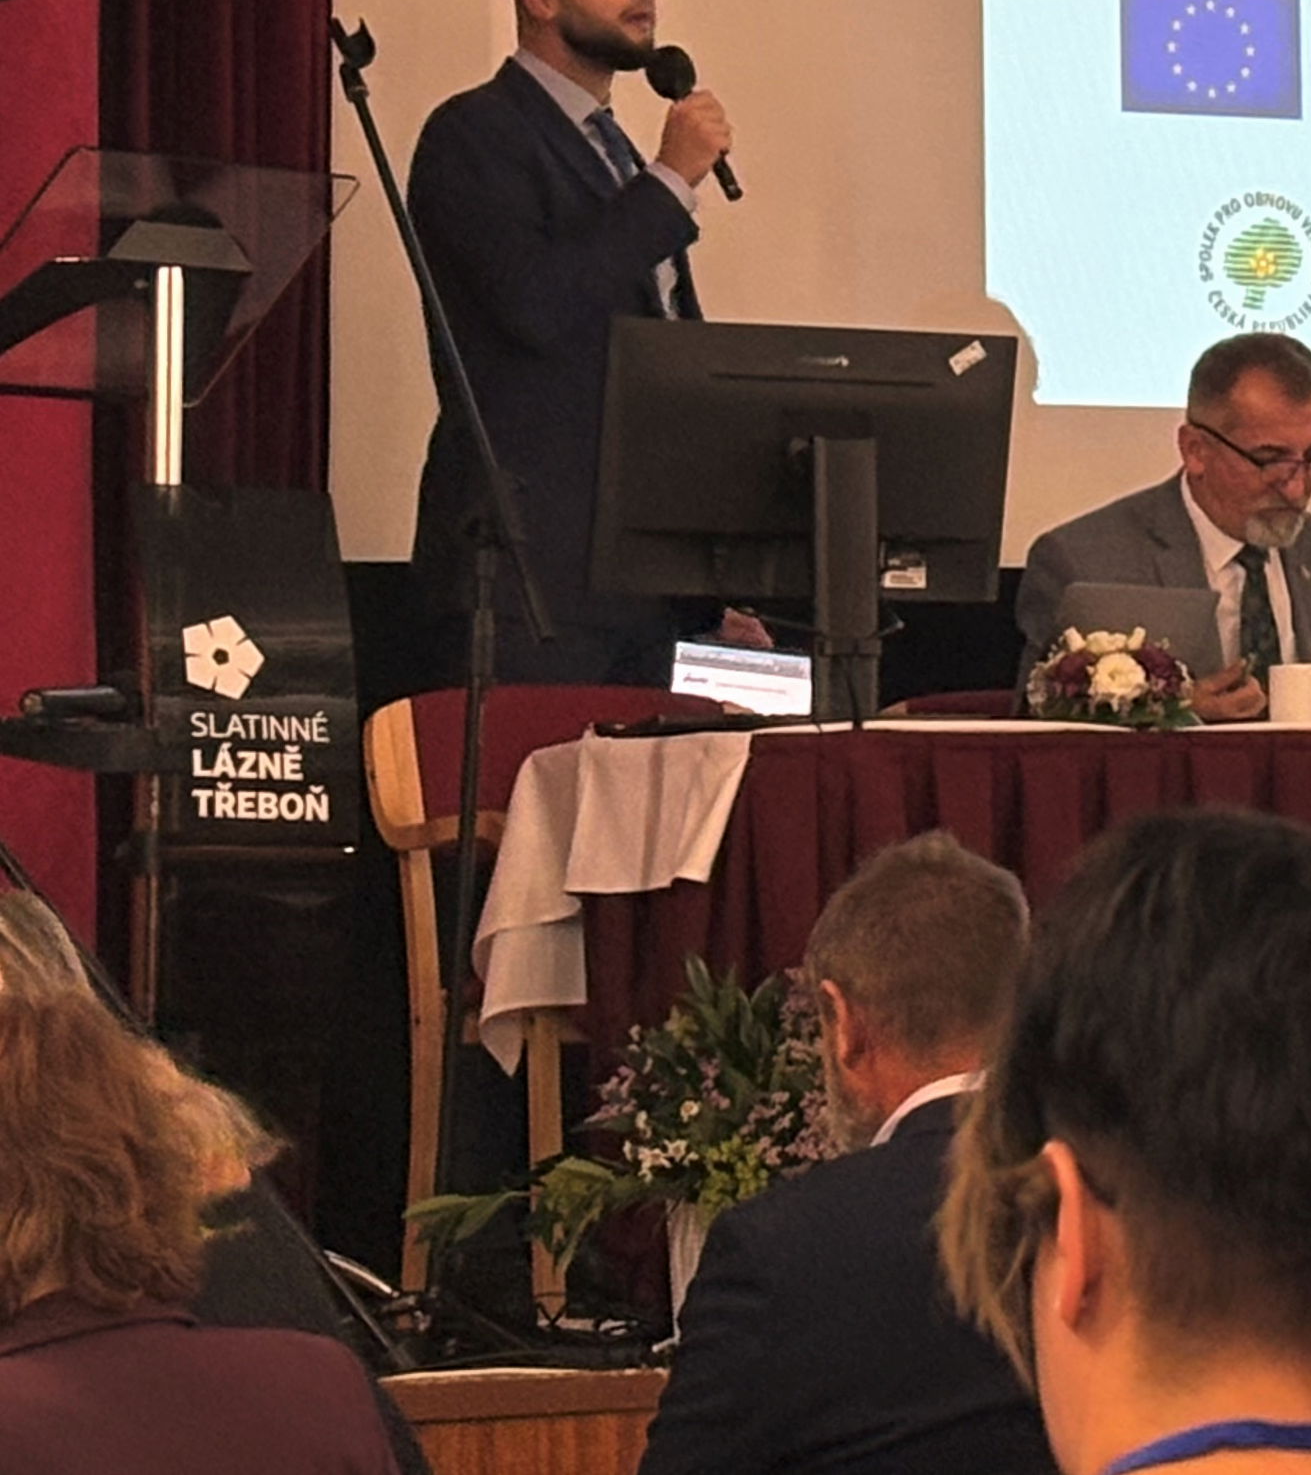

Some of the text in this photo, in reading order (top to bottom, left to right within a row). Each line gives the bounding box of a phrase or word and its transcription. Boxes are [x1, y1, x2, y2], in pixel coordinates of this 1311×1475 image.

[1199, 221, 1221, 283] SPOLEK
[1214, 198, 1242, 226] PRO
[1244, 191, 1304, 221] OBNOVU
[190, 710, 331, 744] SLATINNÉ
[191, 742, 305, 782] LÁZNĚ
[190, 781, 330, 823] TŘEBOŇ
